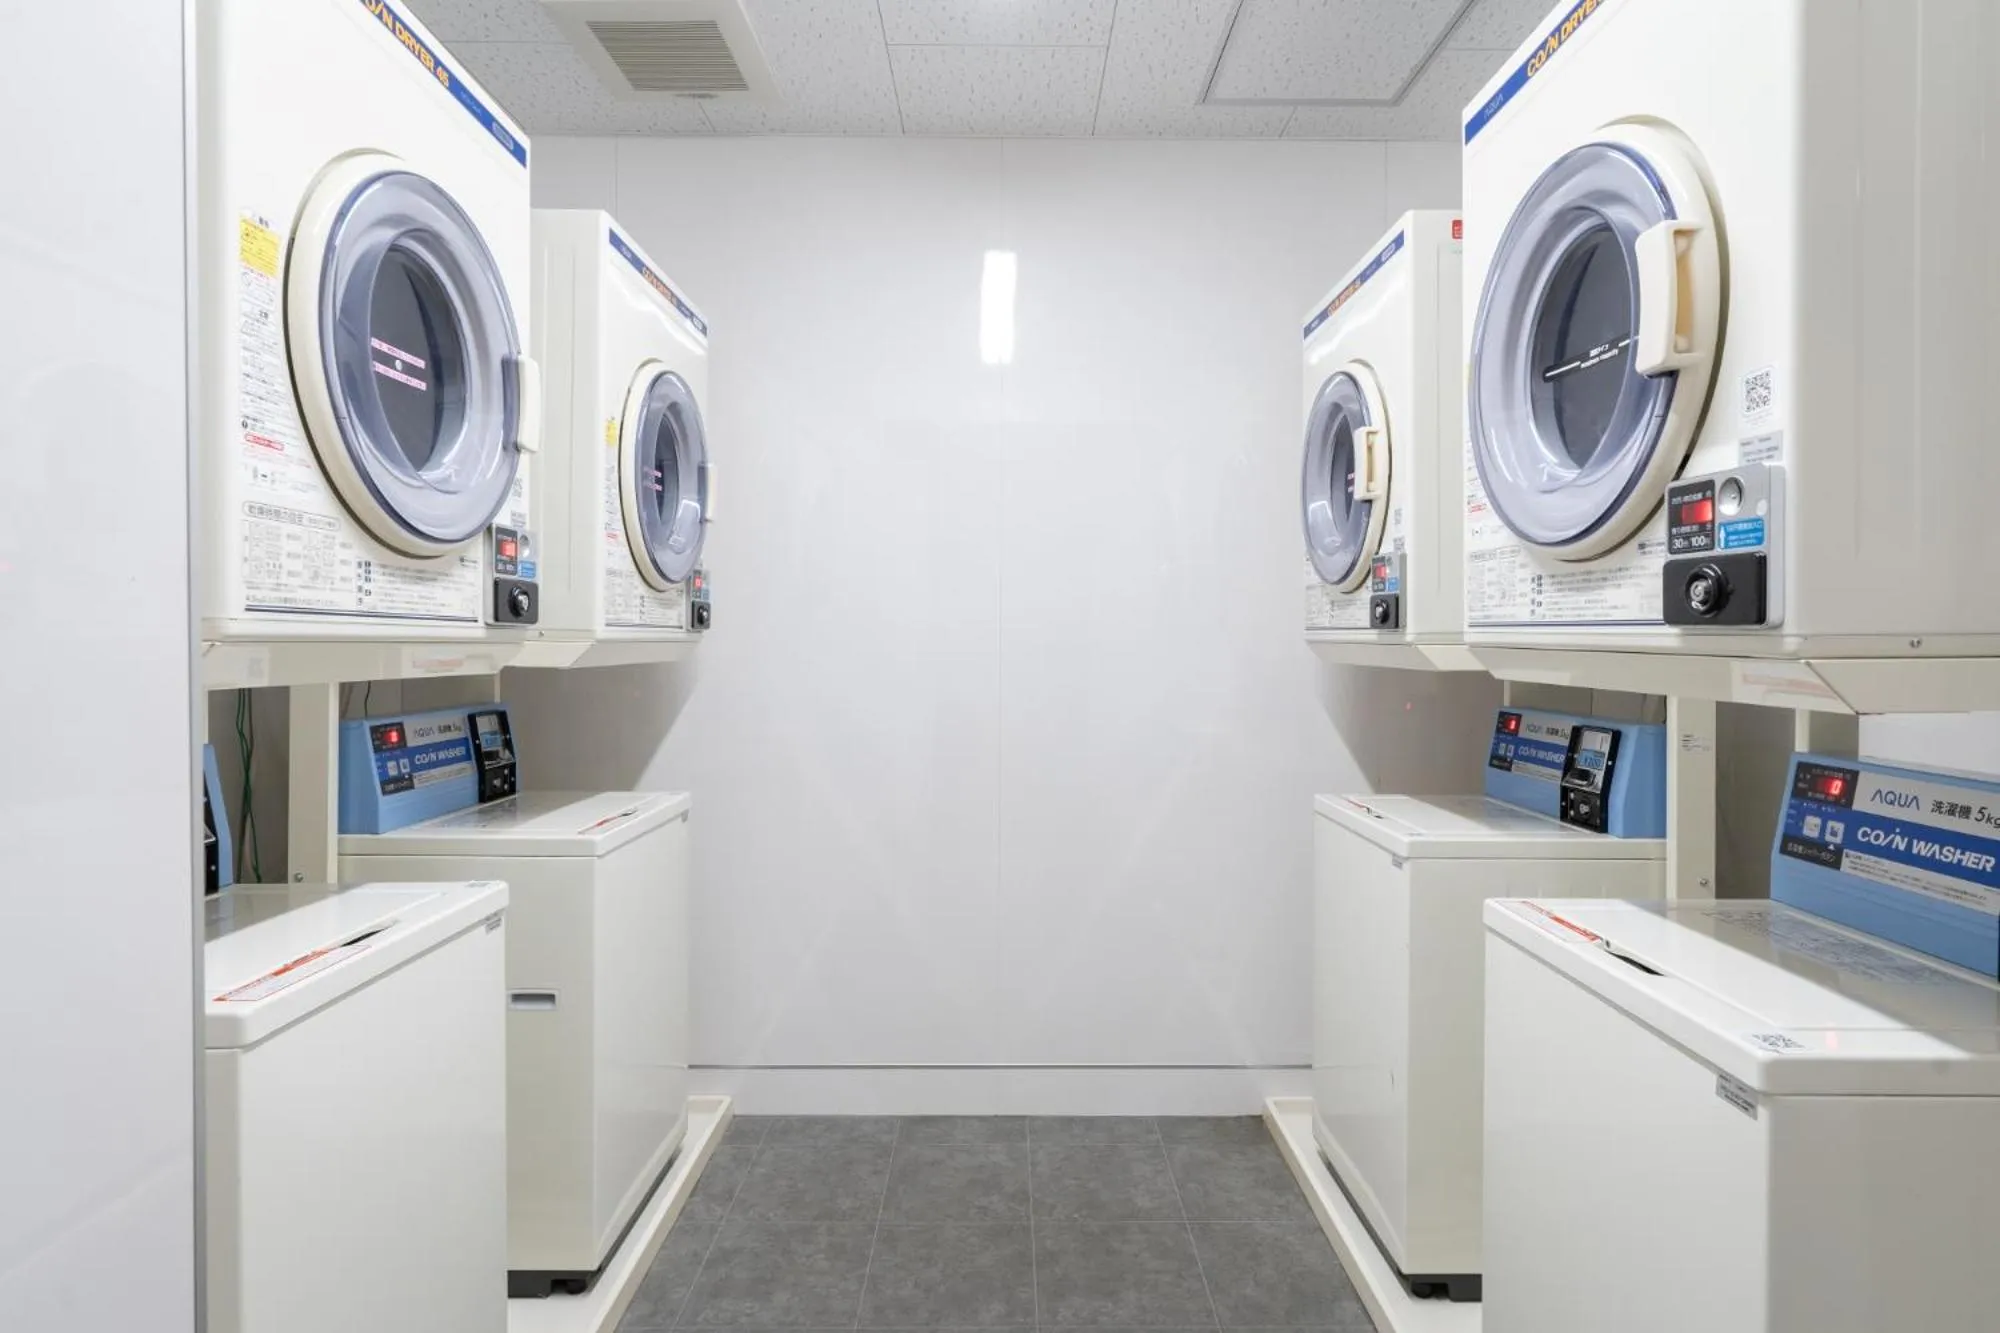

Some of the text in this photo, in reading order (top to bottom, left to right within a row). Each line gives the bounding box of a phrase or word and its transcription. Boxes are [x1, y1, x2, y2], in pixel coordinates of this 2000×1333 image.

[365, 0, 393, 31] OIN
[395, 21, 434, 73] DRYER
[1831, 780, 1842, 796] 0
[1870, 788, 1921, 811] AQUA
[1930, 799, 1972, 820] 洗濯機
[1911, 838, 1996, 873] WASHER
